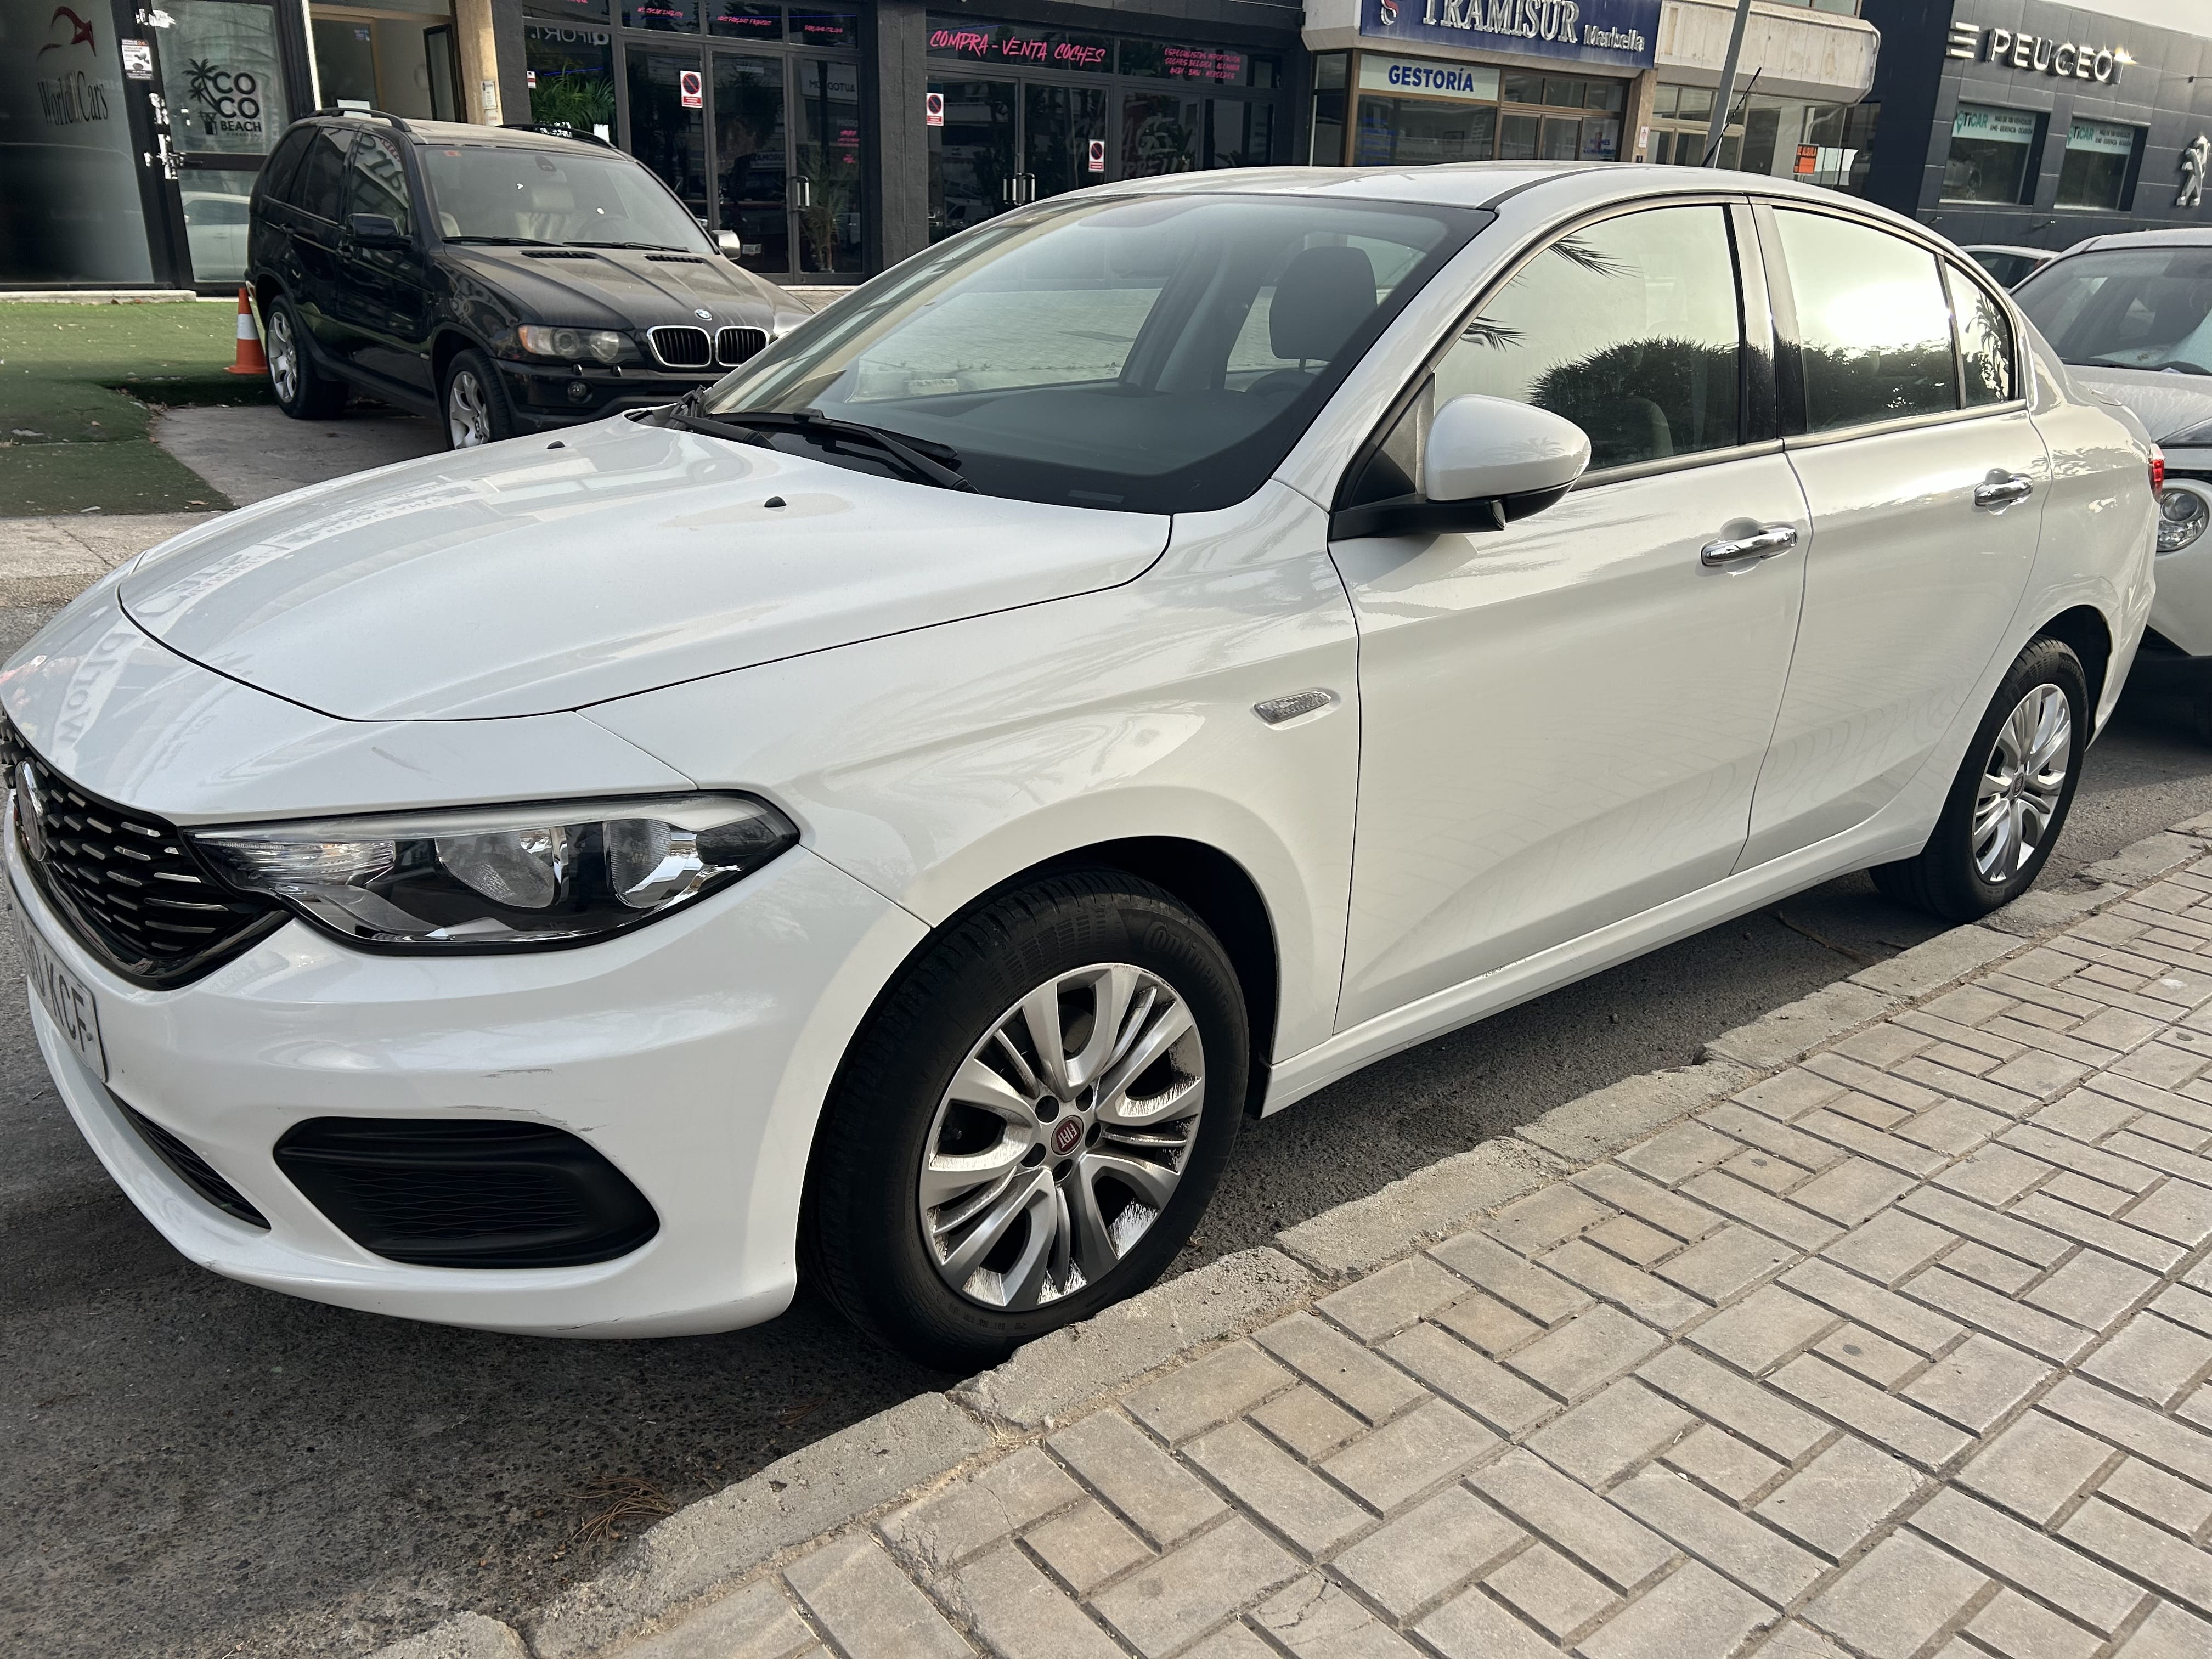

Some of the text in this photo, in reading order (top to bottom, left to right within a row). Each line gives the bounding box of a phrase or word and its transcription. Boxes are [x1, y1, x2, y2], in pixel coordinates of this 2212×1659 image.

[930, 30, 988, 57] COMPRA
[1002, 36, 1047, 61] VENTA
[1054, 43, 1106, 66] COCHES
[1583, 24, 1645, 52] Marbella
[1985, 27, 2134, 85] PEUGEOT
[1388, 64, 1474, 92] GESTORÍA
[77, 71, 108, 122] Cars
[221, 121, 262, 132] BEACH
[1058, 1122, 1078, 1149] FIAT
